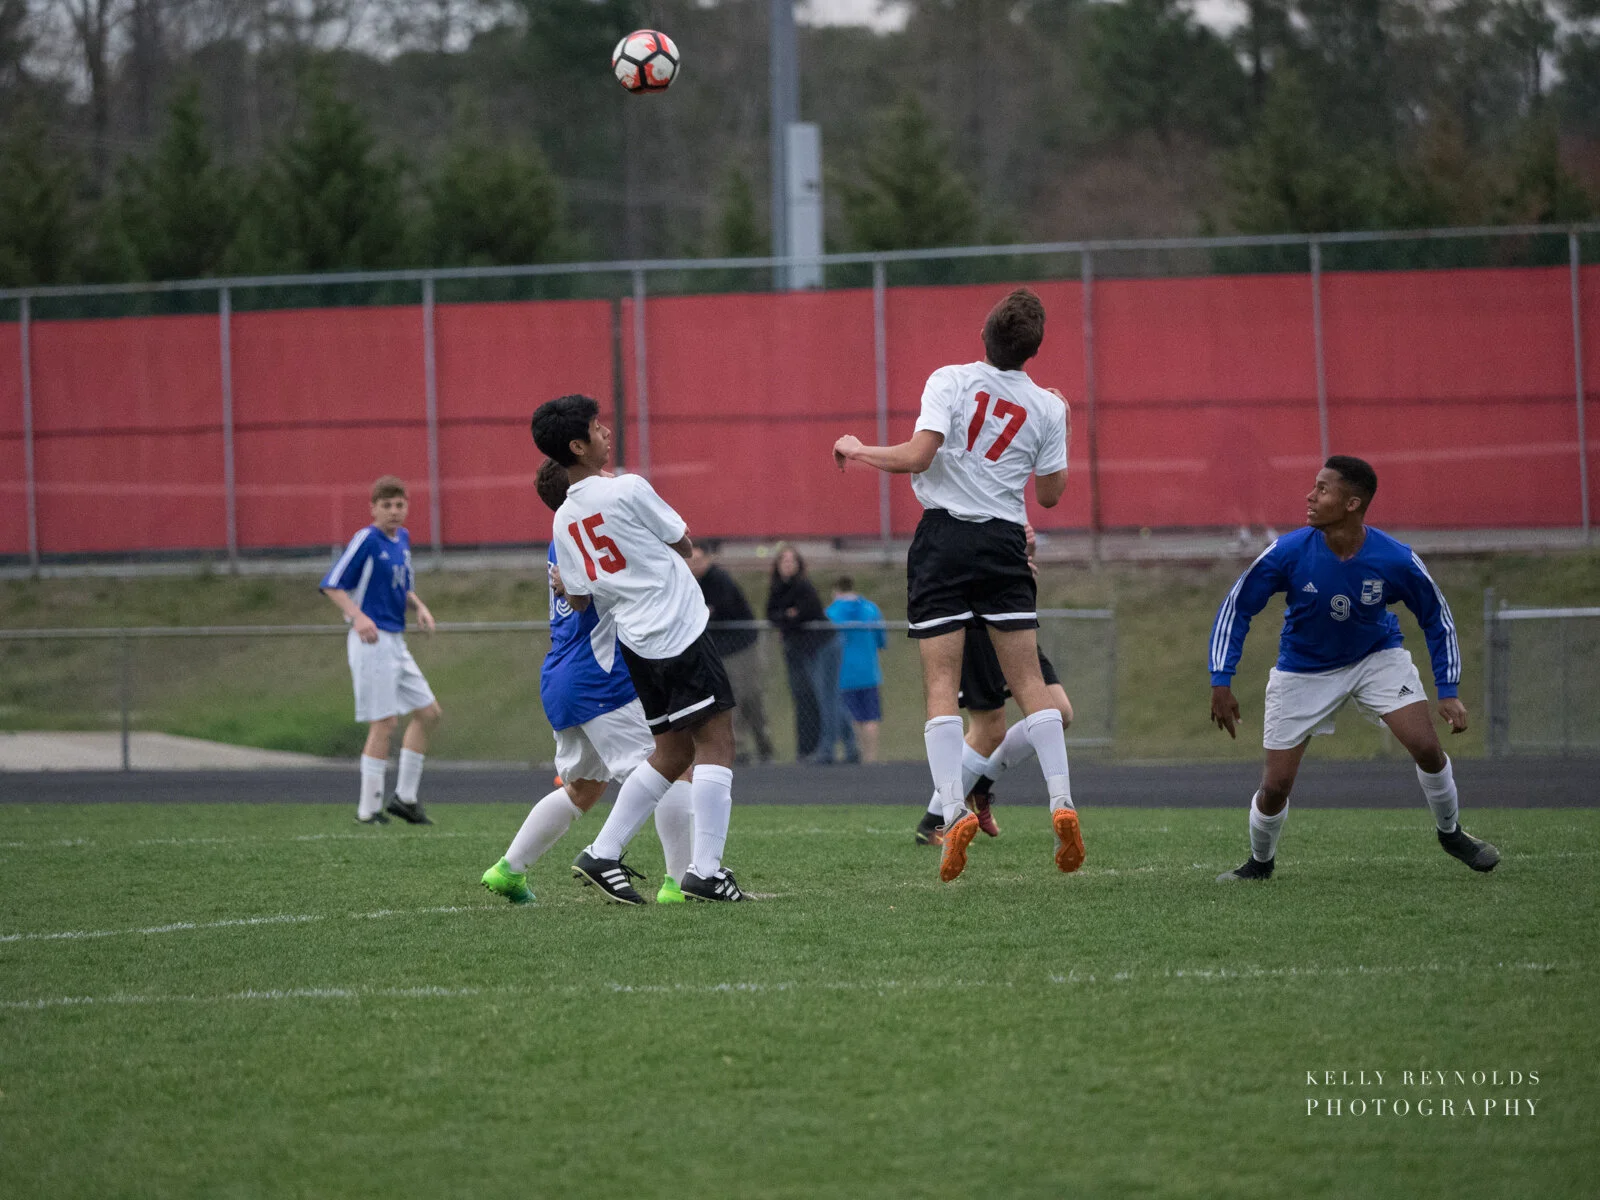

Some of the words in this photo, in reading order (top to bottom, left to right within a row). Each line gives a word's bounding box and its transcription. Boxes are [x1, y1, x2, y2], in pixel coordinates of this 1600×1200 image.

[966, 391, 1027, 462] 17
[568, 512, 626, 581] 15
[1330, 594, 1350, 622] 9
